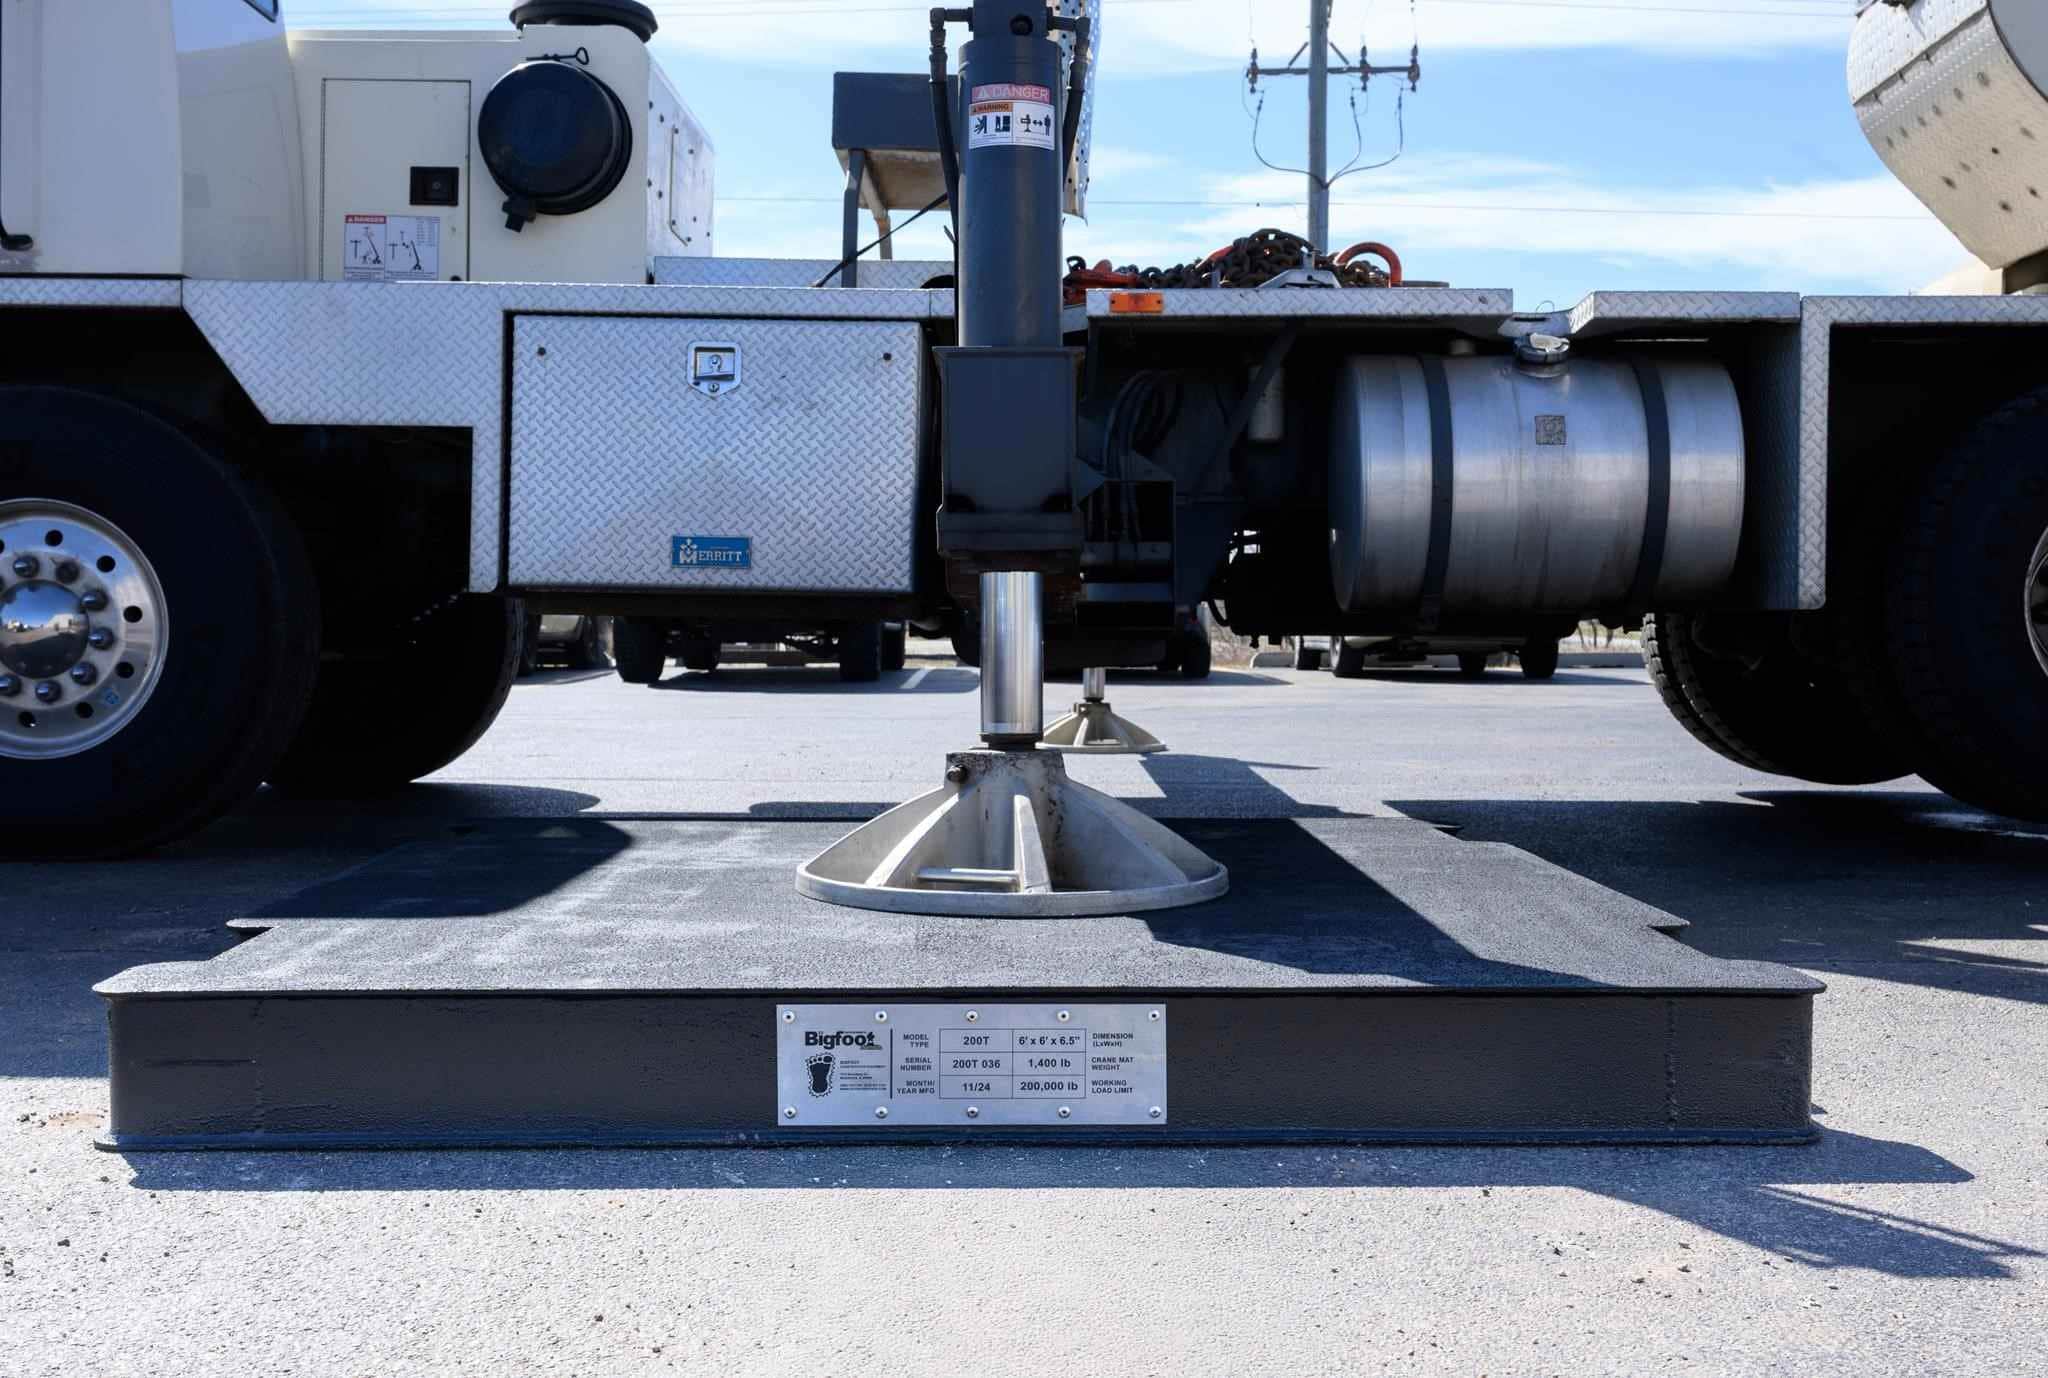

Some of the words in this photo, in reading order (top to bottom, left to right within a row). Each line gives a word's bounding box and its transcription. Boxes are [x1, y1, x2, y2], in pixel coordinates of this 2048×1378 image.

[992, 86, 1049, 99] DANGER
[978, 103, 1009, 112] WARNING
[680, 549, 742, 564] MERRITT
[805, 1031, 875, 1049] Bigfoot
[963, 1036, 990, 1046] 200T
[1018, 1036, 1029, 1046] 6'
[1039, 1036, 1049, 1046] 6'
[952, 1059, 978, 1069] 200T
[981, 1059, 1001, 1069] 036
[1028, 1059, 1057, 1069] 1,400
[1060, 1059, 1071, 1068] lb
[963, 1082, 991, 1092] 11/24
[1020, 1082, 1064, 1092] 200,000
[1067, 1082, 1078, 1091] lb
